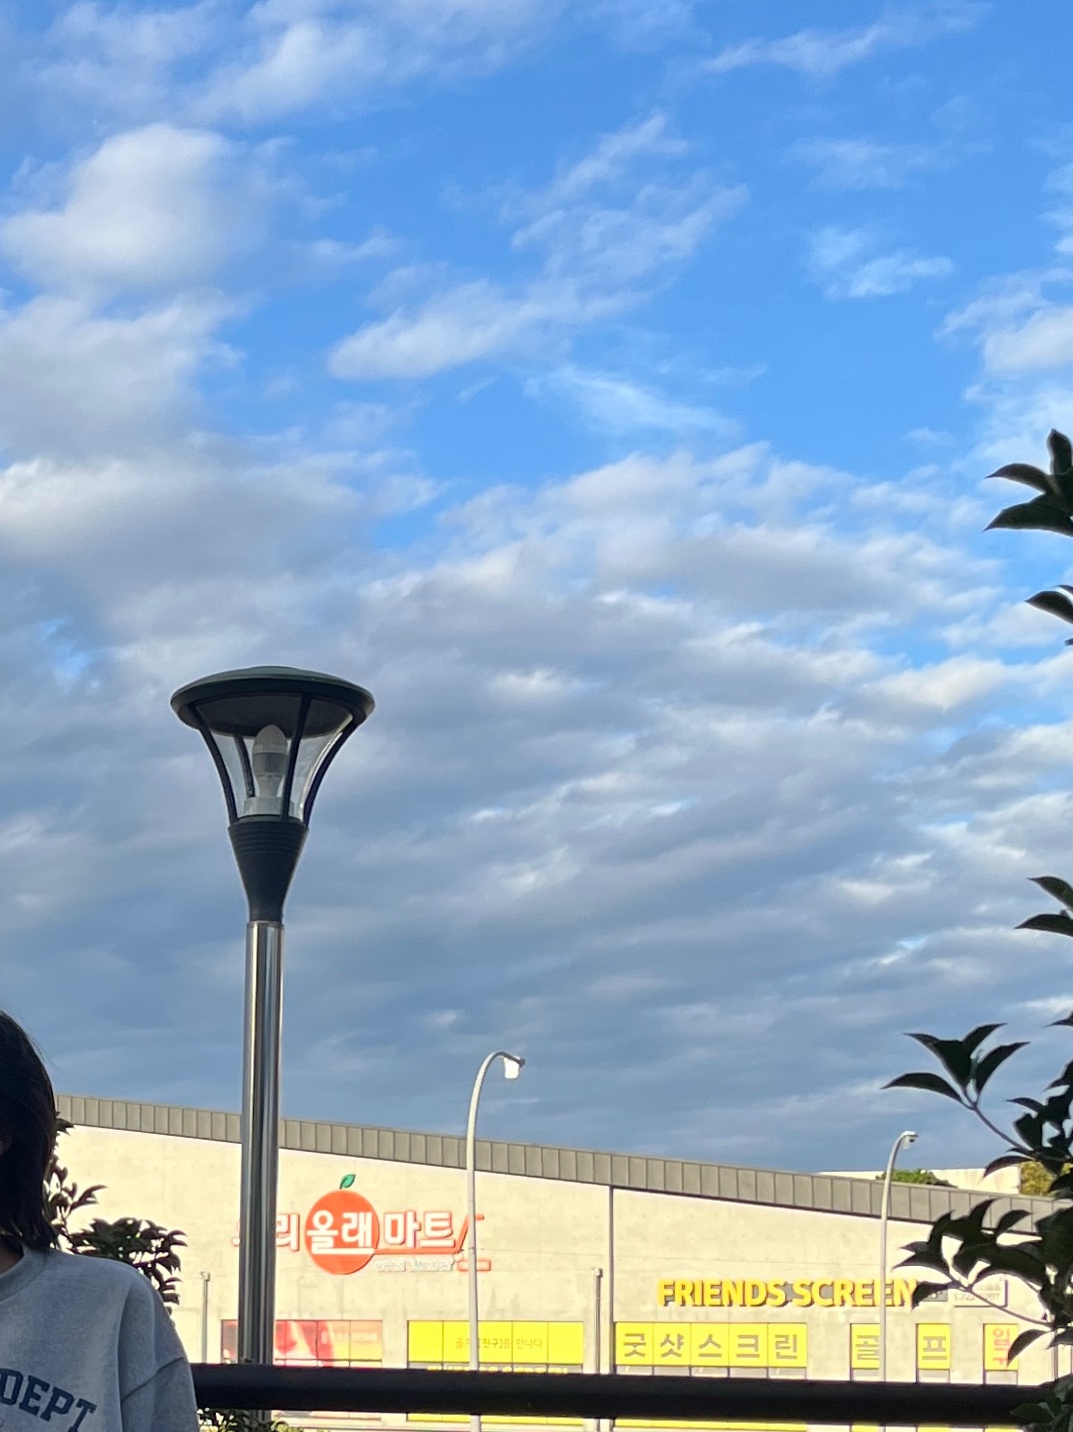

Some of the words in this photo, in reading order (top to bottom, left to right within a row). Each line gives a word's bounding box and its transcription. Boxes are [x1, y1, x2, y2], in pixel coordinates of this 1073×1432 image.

[658, 1279, 787, 1307] FRIENDS
[791, 1278, 917, 1308] SCREEN
[623, 1333, 799, 1360] 굿샷스크린
